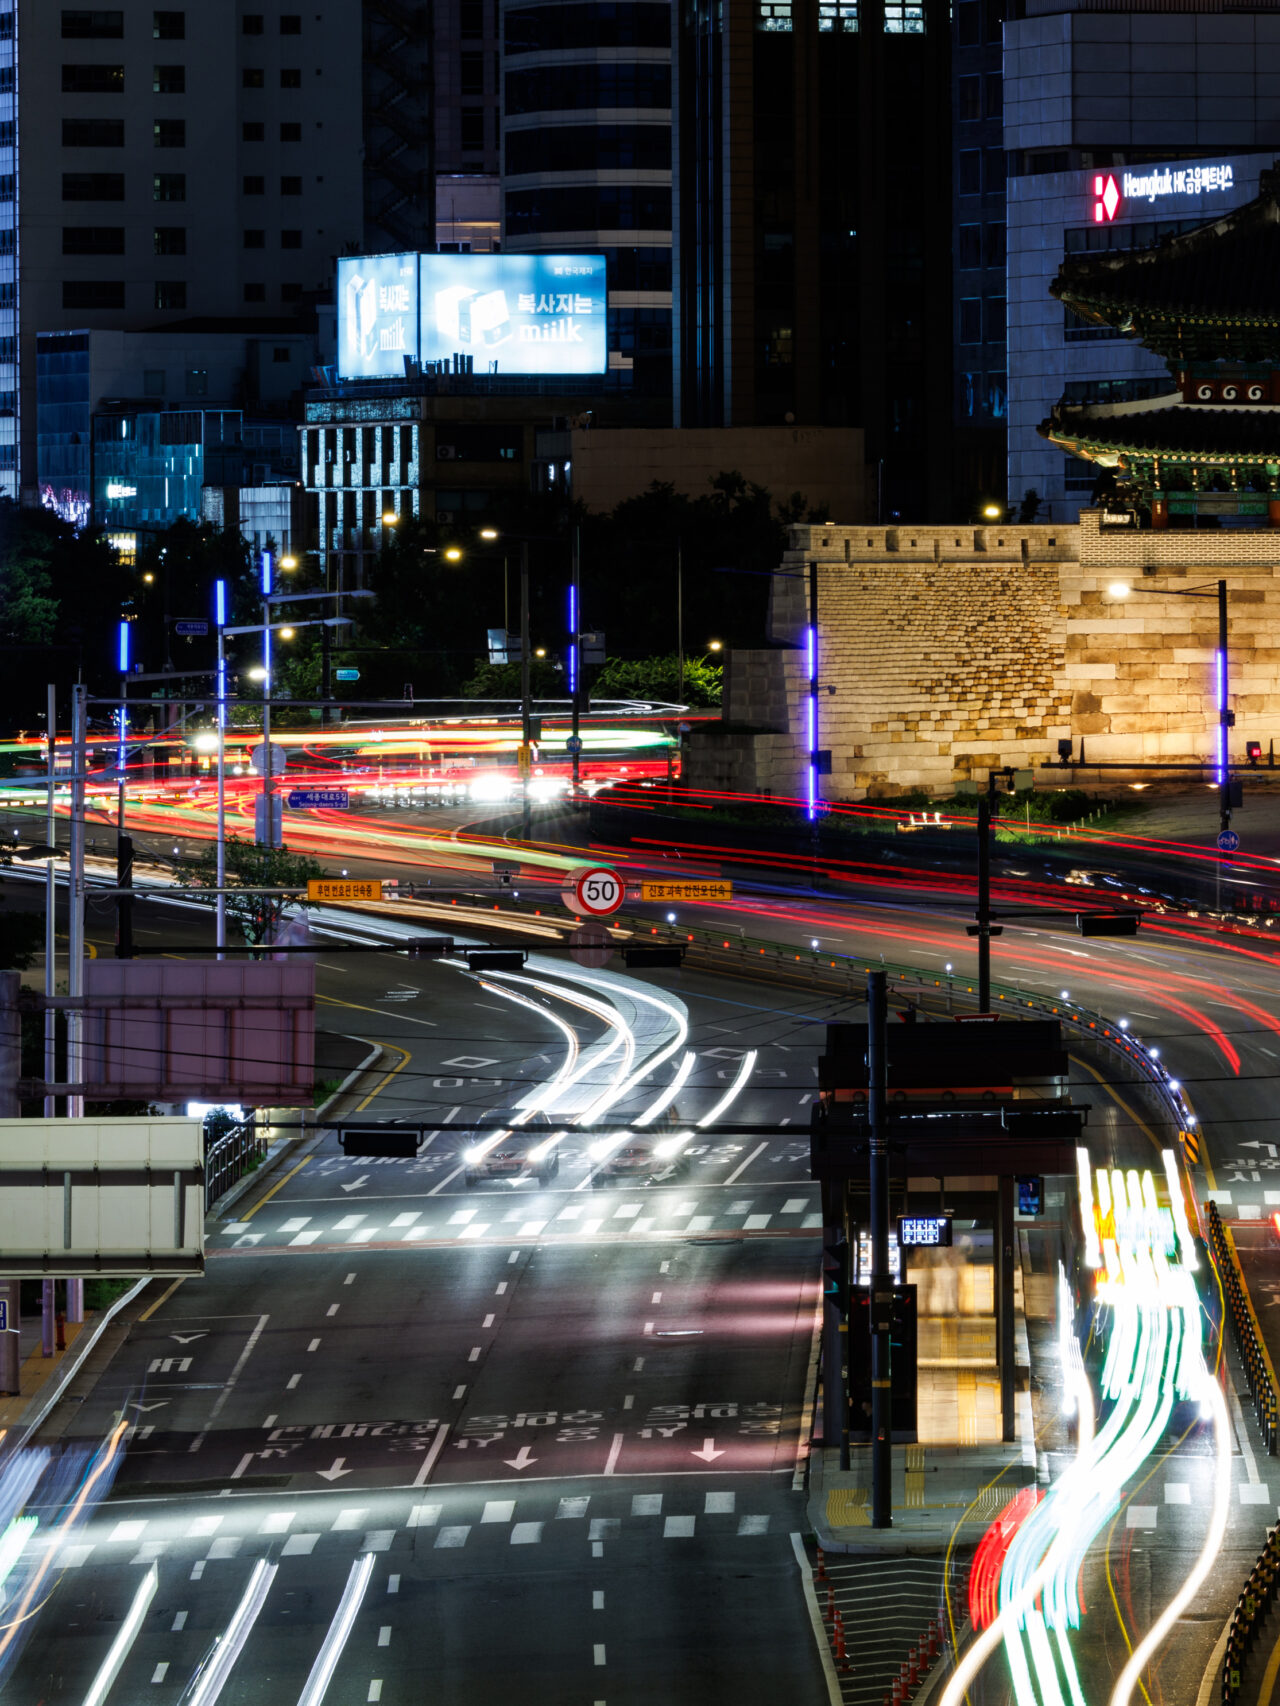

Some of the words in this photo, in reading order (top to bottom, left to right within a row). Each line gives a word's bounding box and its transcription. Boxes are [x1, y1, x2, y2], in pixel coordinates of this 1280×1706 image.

[1123, 168, 1173, 203] Heungkuk
[517, 293, 593, 315] 복사지는
[519, 316, 584, 343] miilk
[587, 881, 615, 901] 50
